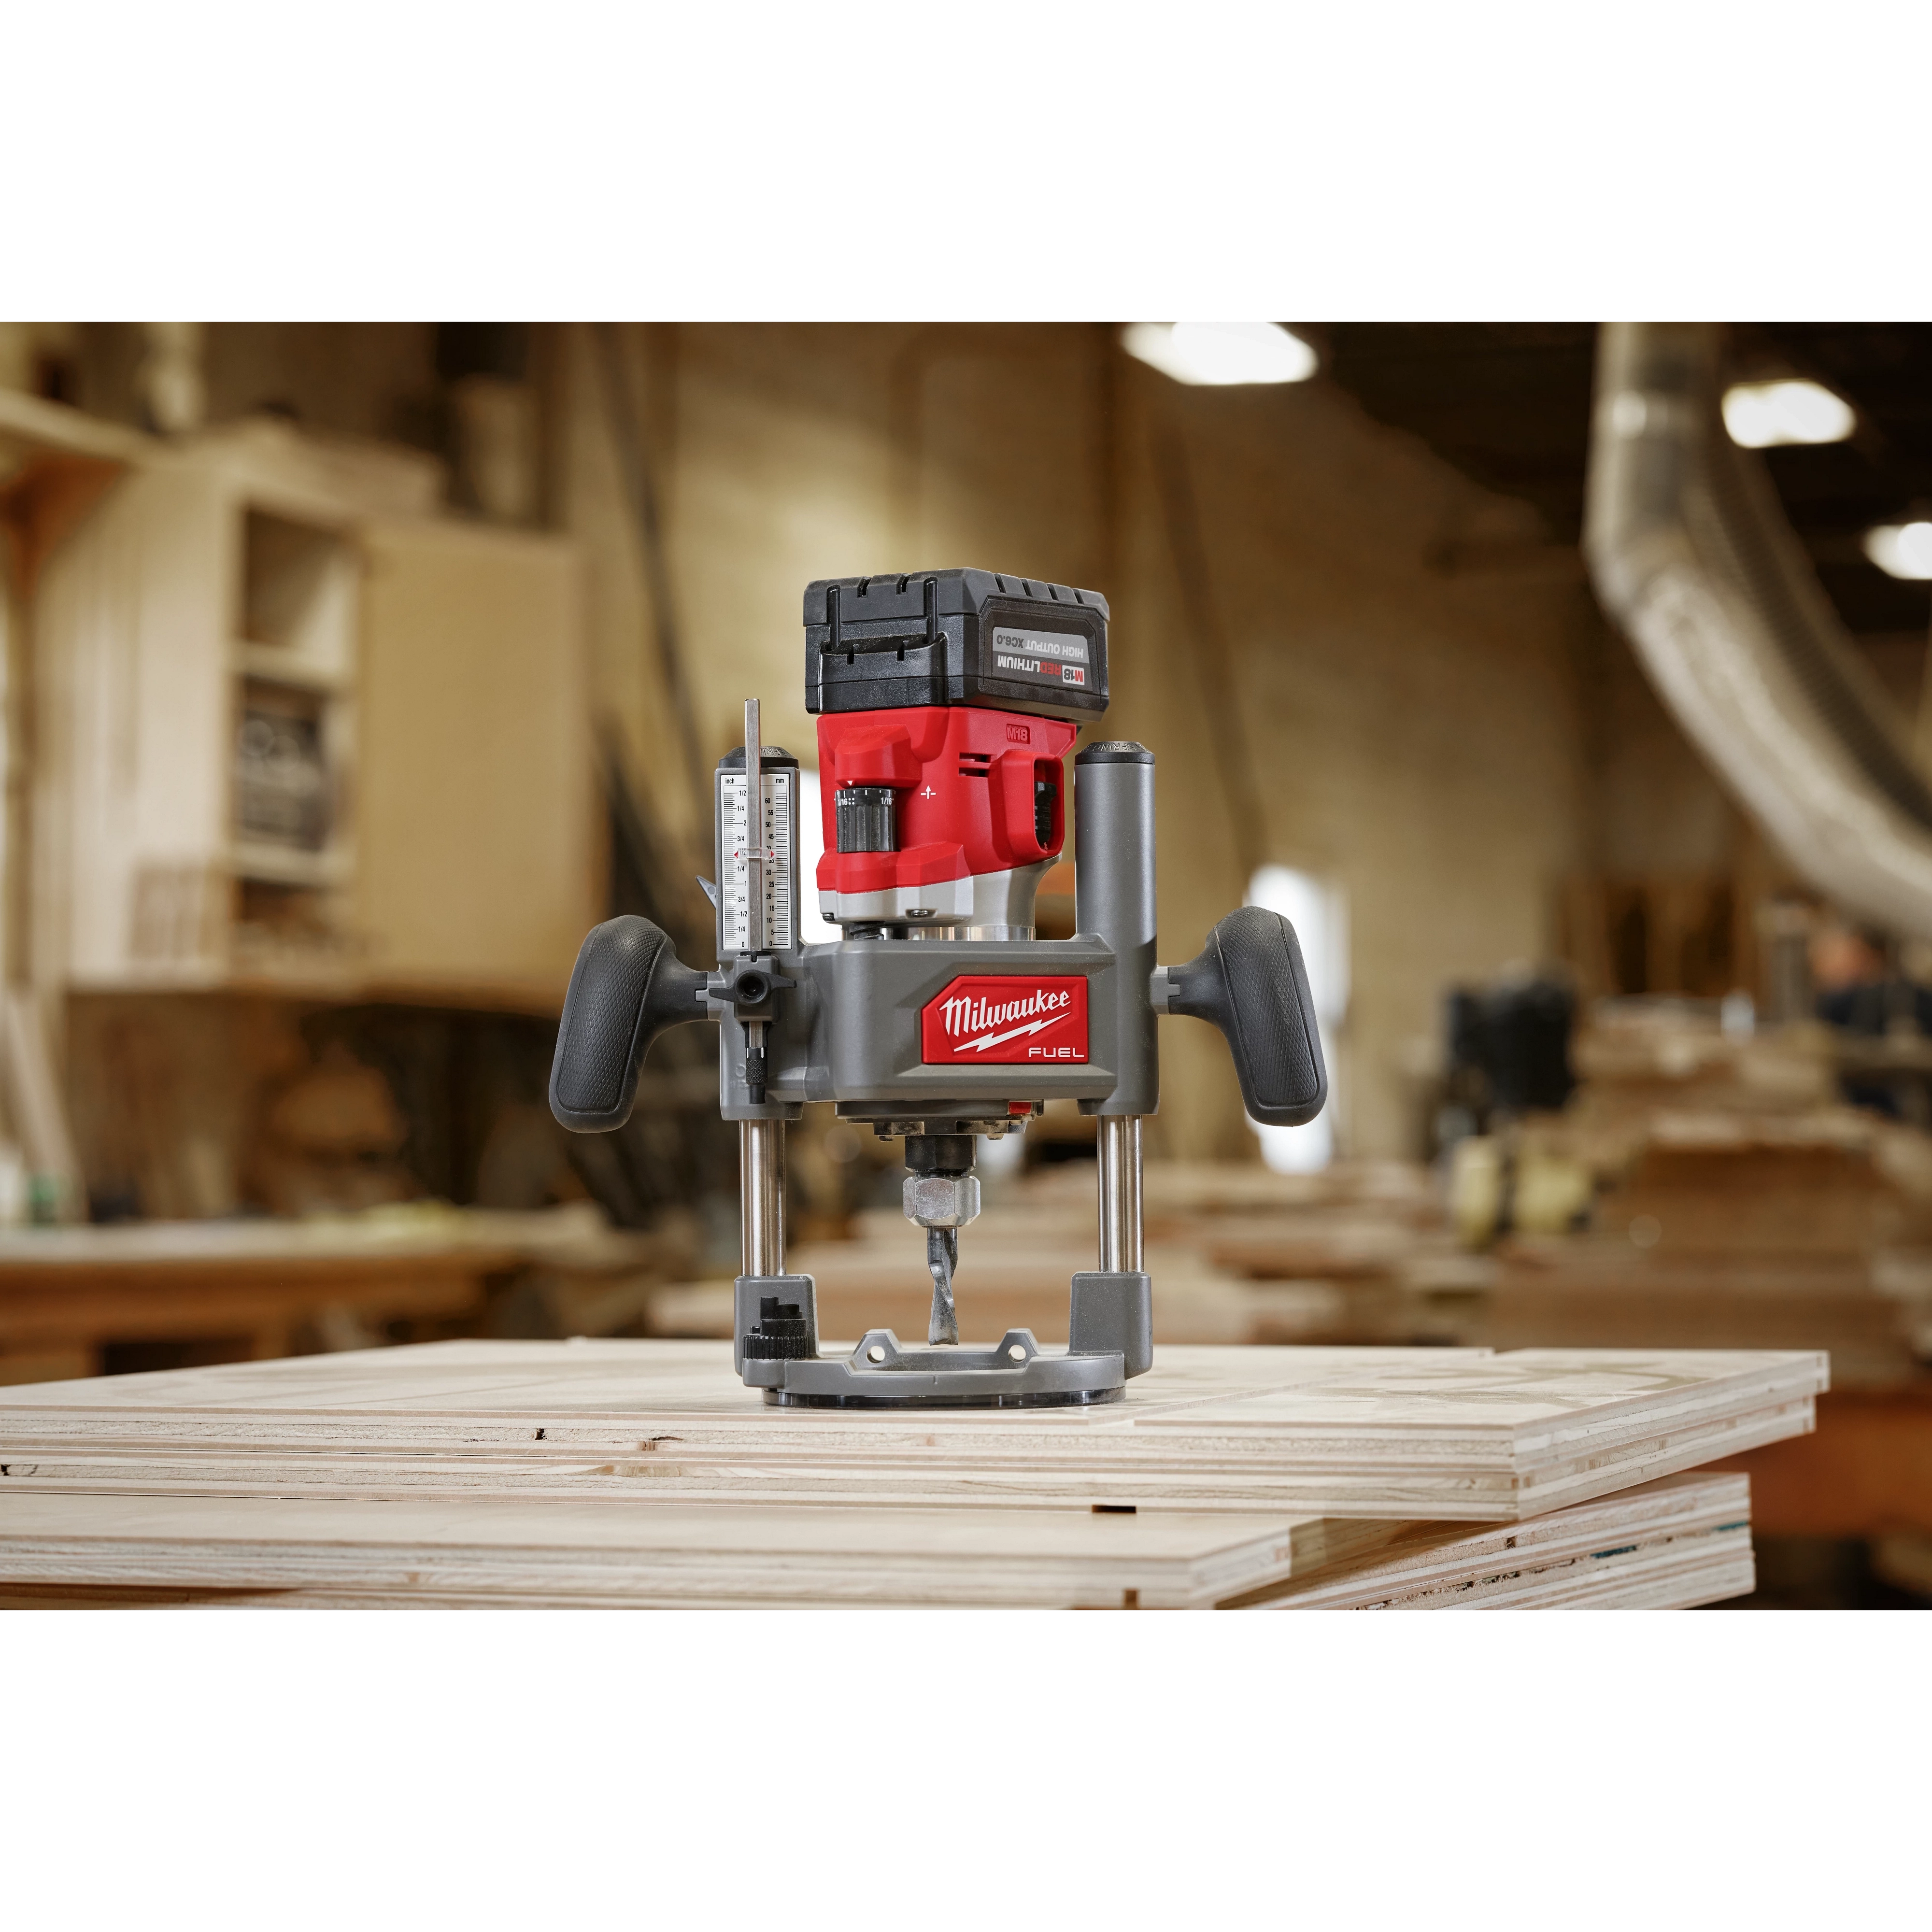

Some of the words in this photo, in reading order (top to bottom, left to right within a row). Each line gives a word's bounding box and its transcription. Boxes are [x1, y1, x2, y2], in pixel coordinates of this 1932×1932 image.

[996, 635, 1024, 648] XC6.0
[1025, 640, 1060, 654] OUTPUT
[1062, 645, 1083, 658] HIGH
[1064, 668, 1083, 682] M18
[1007, 727, 1028, 741] M18
[939, 989, 1071, 1037] Milwaukee
[1029, 1047, 1084, 1058] FUEL
